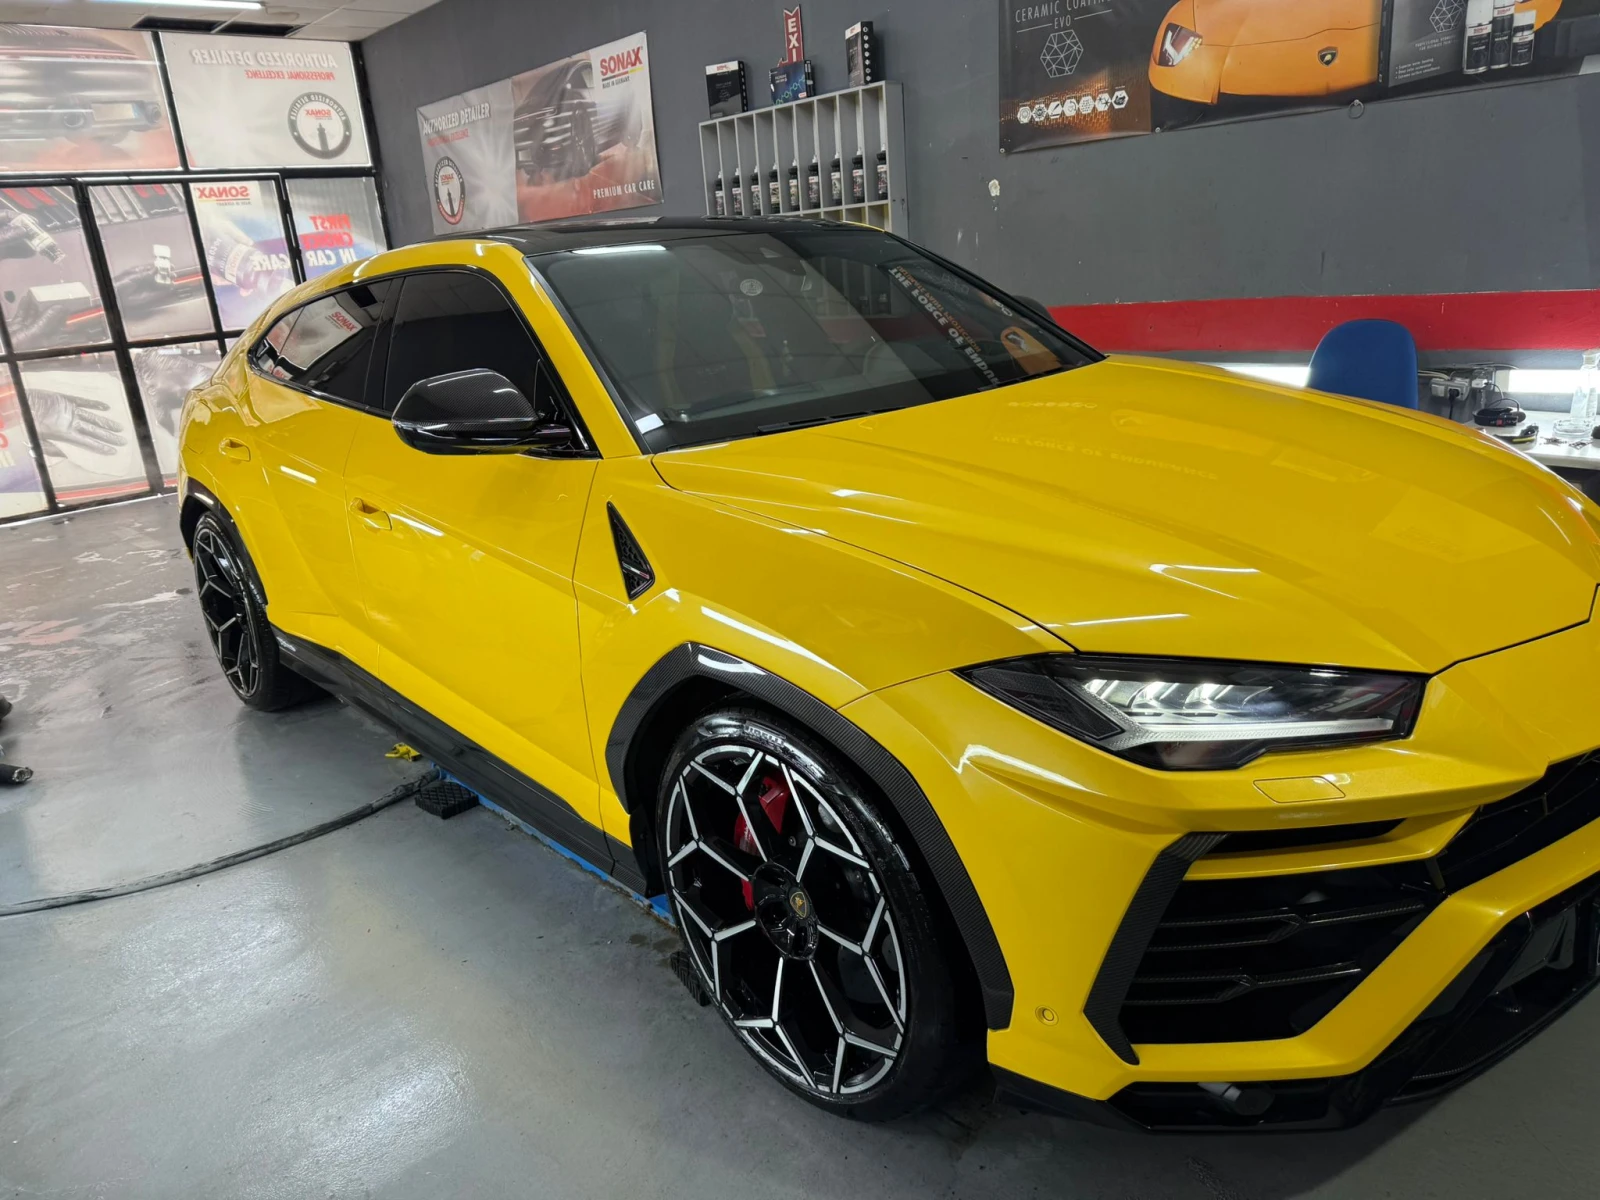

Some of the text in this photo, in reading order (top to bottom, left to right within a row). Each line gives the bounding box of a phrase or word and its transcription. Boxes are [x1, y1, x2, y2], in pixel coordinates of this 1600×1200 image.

[1015, 1, 1060, 23] CERAMIC
[1054, 15, 1072, 29] EVO
[788, 17, 799, 62] EXI
[600, 47, 643, 76] SONAX
[460, 102, 490, 125] DETAILER
[593, 180, 655, 199] PREMIUM CAR CARE
[331, 311, 358, 332] SONAX
